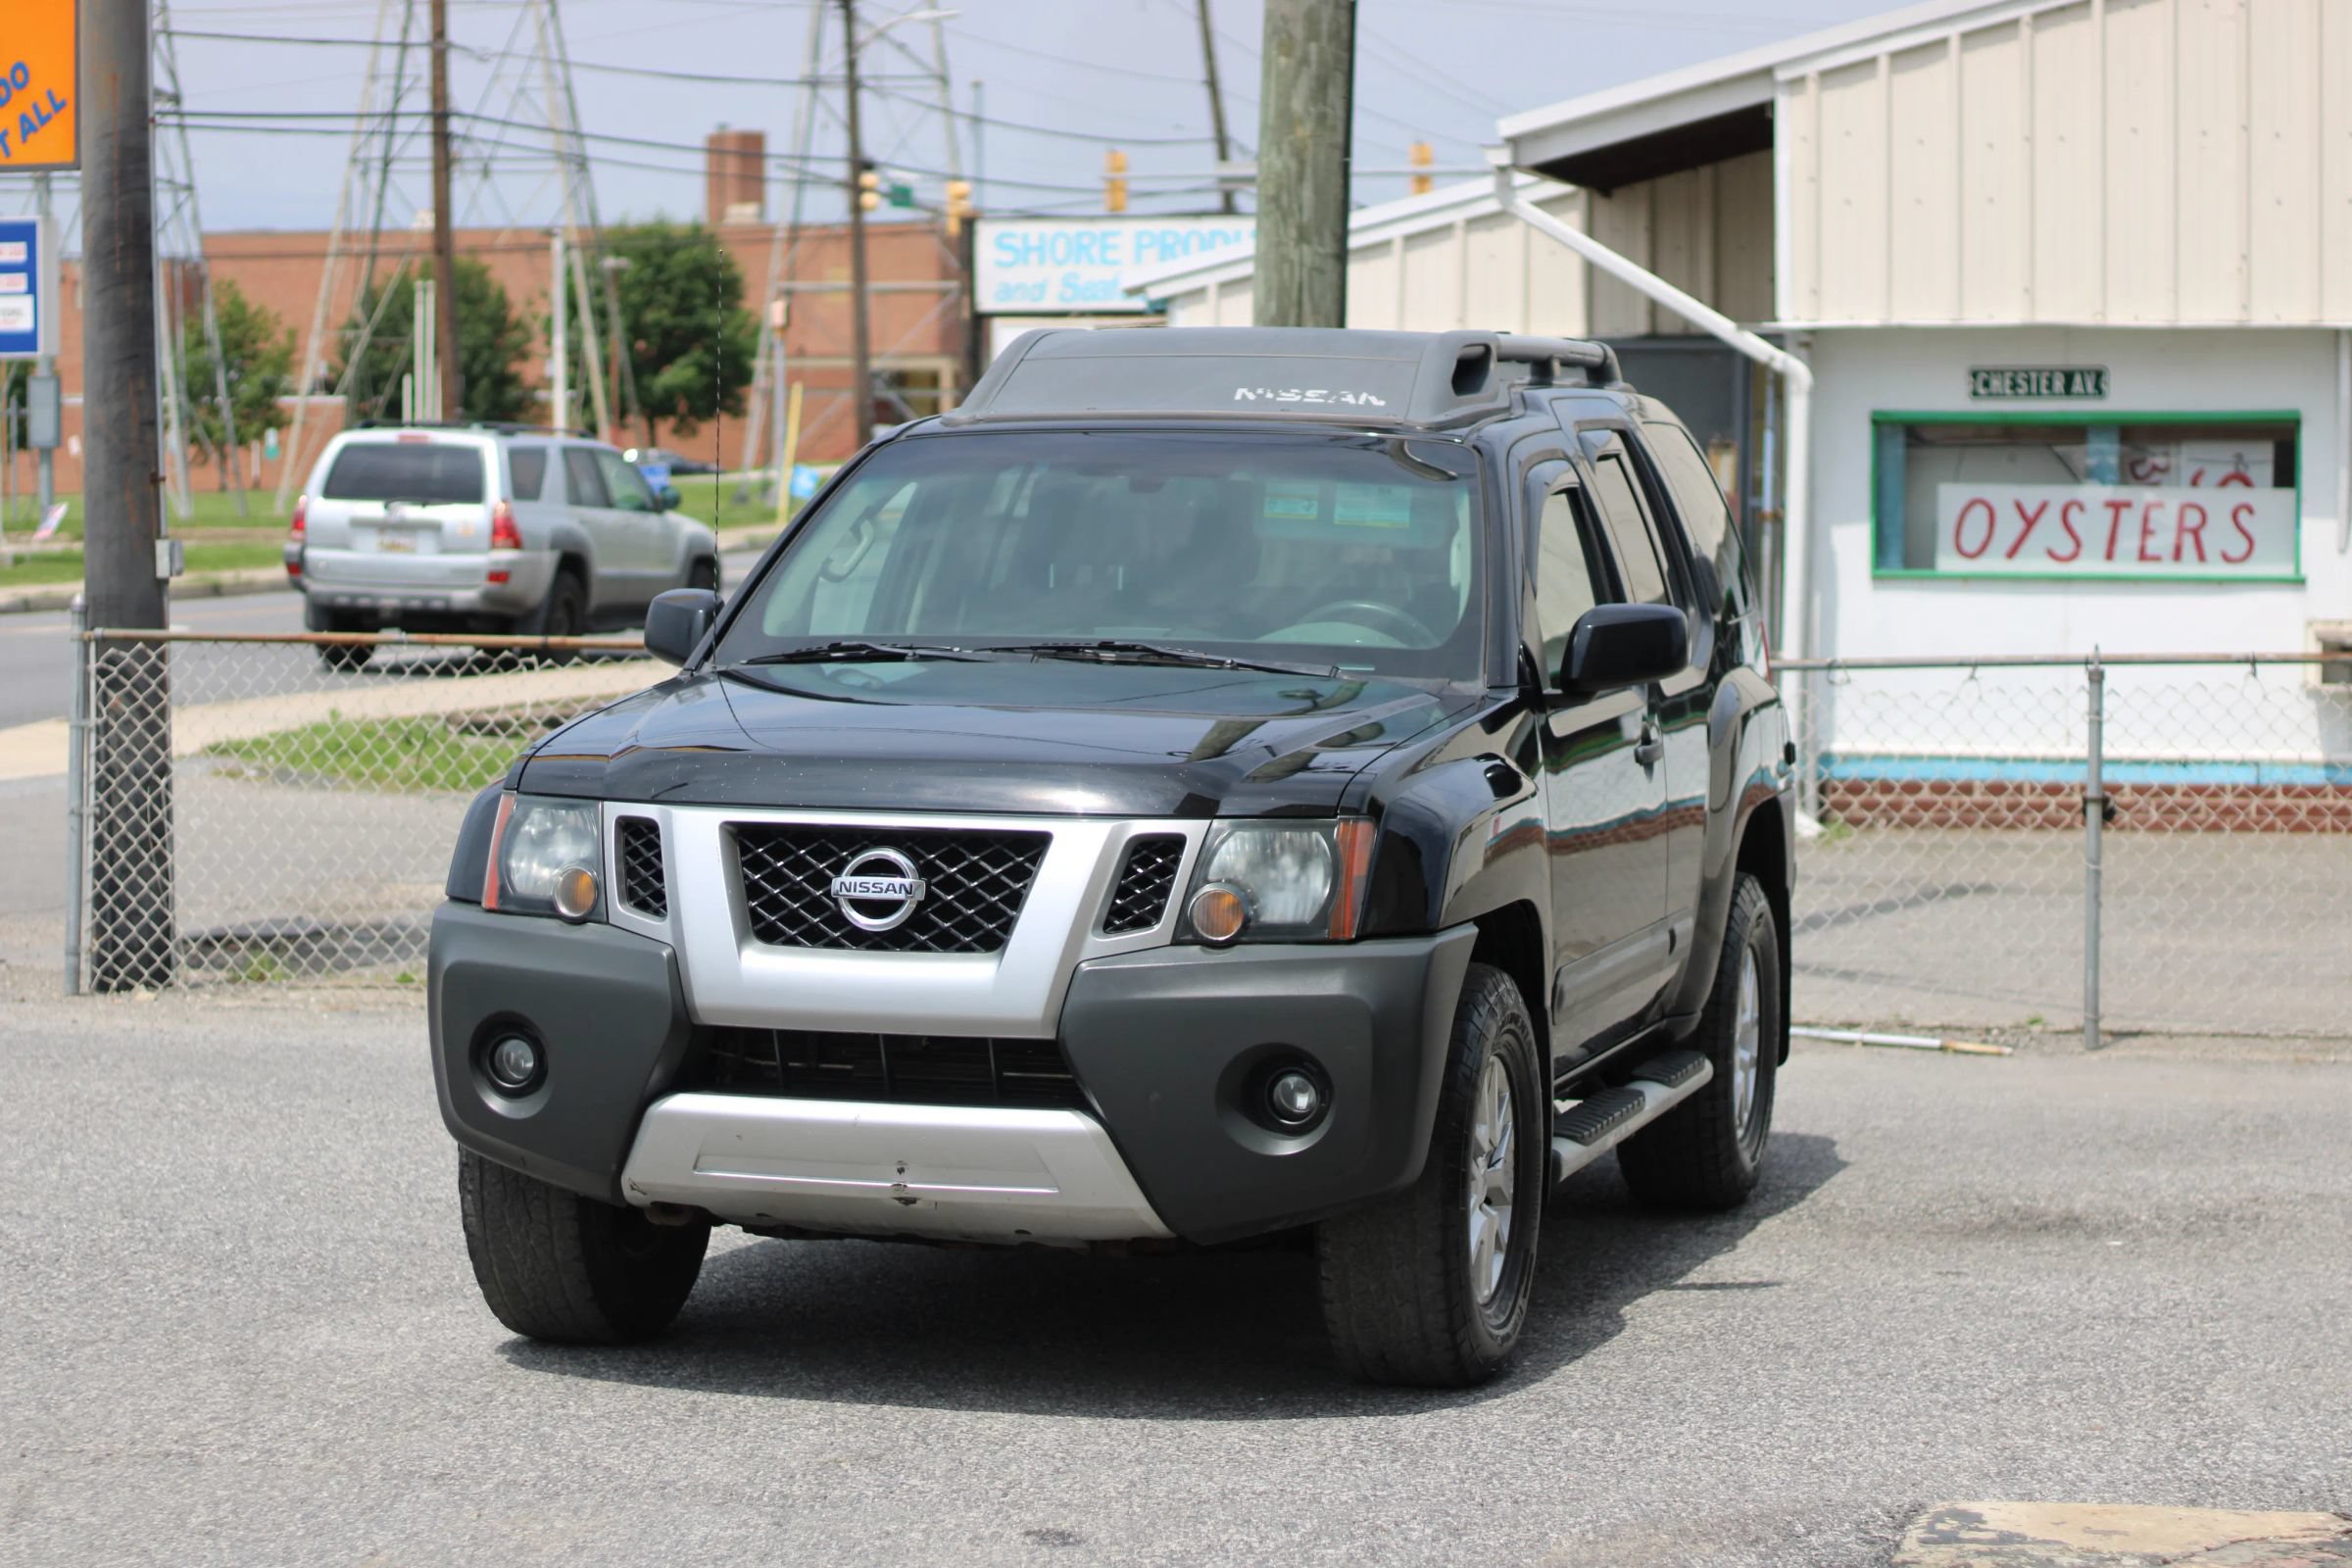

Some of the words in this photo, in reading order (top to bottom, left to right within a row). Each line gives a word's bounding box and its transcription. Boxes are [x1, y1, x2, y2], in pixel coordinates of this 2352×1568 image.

[19, 88, 68, 144] ALL
[993, 229, 1122, 268] SHORE
[995, 278, 1048, 303] and
[1975, 369, 2065, 395] CHESTER
[1954, 497, 2255, 564] OYSTERS
[839, 881, 913, 895] NISSAN
